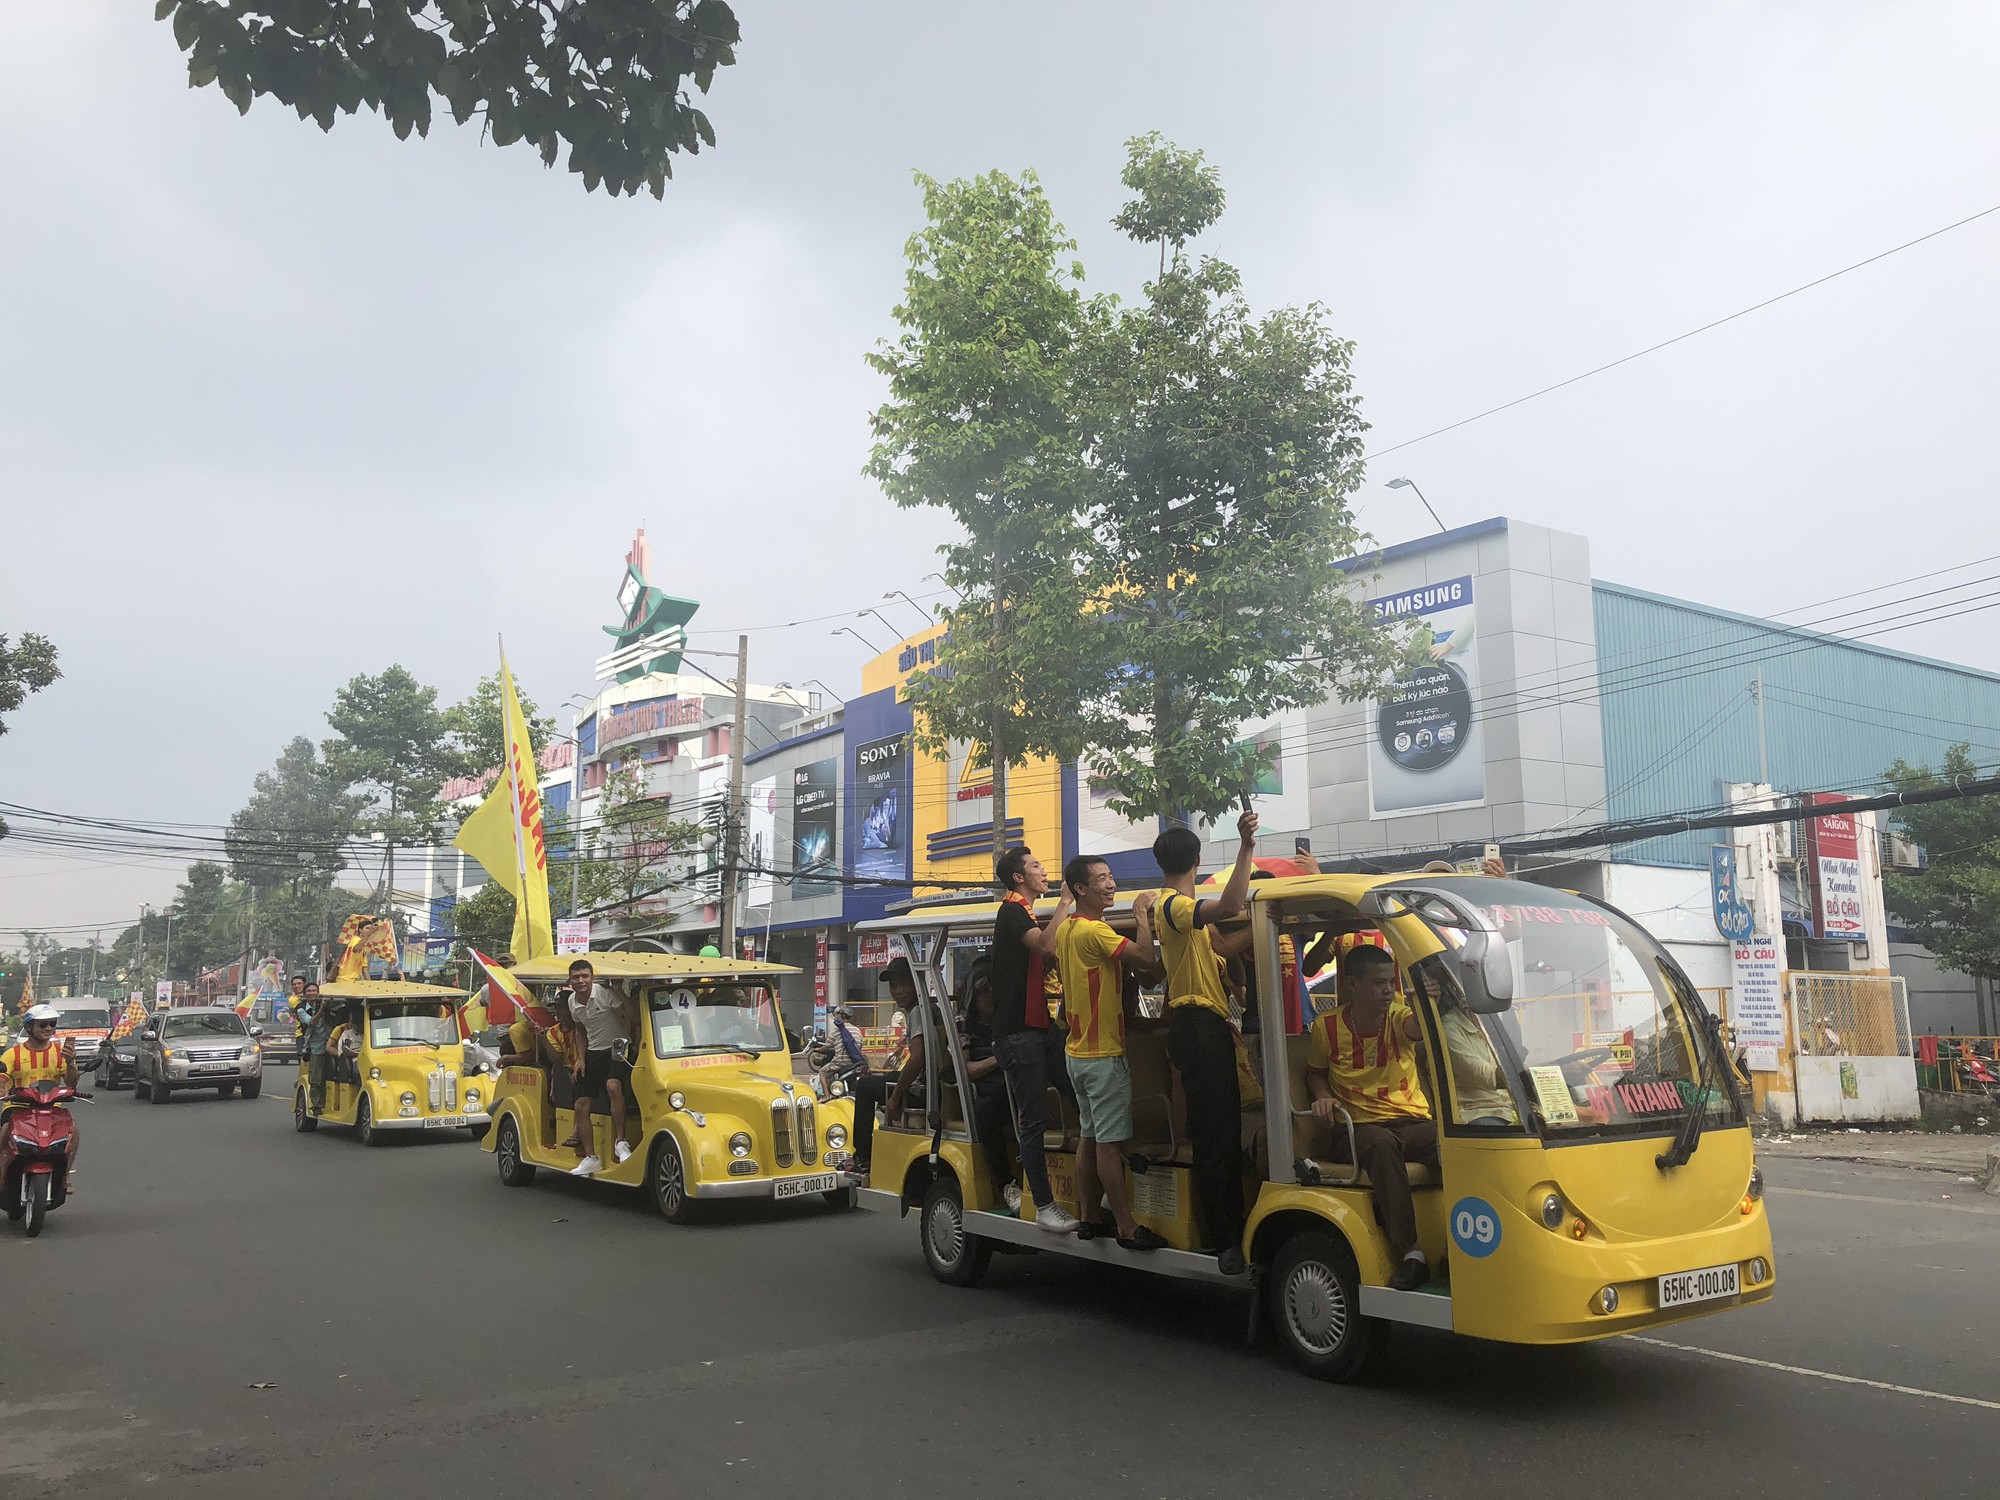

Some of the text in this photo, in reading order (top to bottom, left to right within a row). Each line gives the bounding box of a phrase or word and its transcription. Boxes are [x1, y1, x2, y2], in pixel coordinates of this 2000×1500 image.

[1375, 583, 1462, 619] SAMSUNG
[1396, 717, 1422, 727] Samsung
[860, 743, 899, 766] SONY
[801, 773, 809, 782] LG
[868, 771, 891, 783] BRAVIA
[796, 795, 803, 805] LG
[818, 789, 825, 799] TV
[1827, 877, 1857, 893] Karaoke
[1511, 905, 1564, 924] 738
[1560, 907, 1612, 926] 738
[876, 949, 888, 963] GIÁ
[1754, 947, 1775, 960] CÂU
[678, 993, 689, 1010] 4
[1047, 1156, 1065, 1169] 292
[777, 1177, 834, 1197] 65HC-000.12
[1055, 1174, 1073, 1197] 738
[1456, 1211, 1495, 1243] 09
[1663, 1268, 1736, 1303] 65HC-000.08
